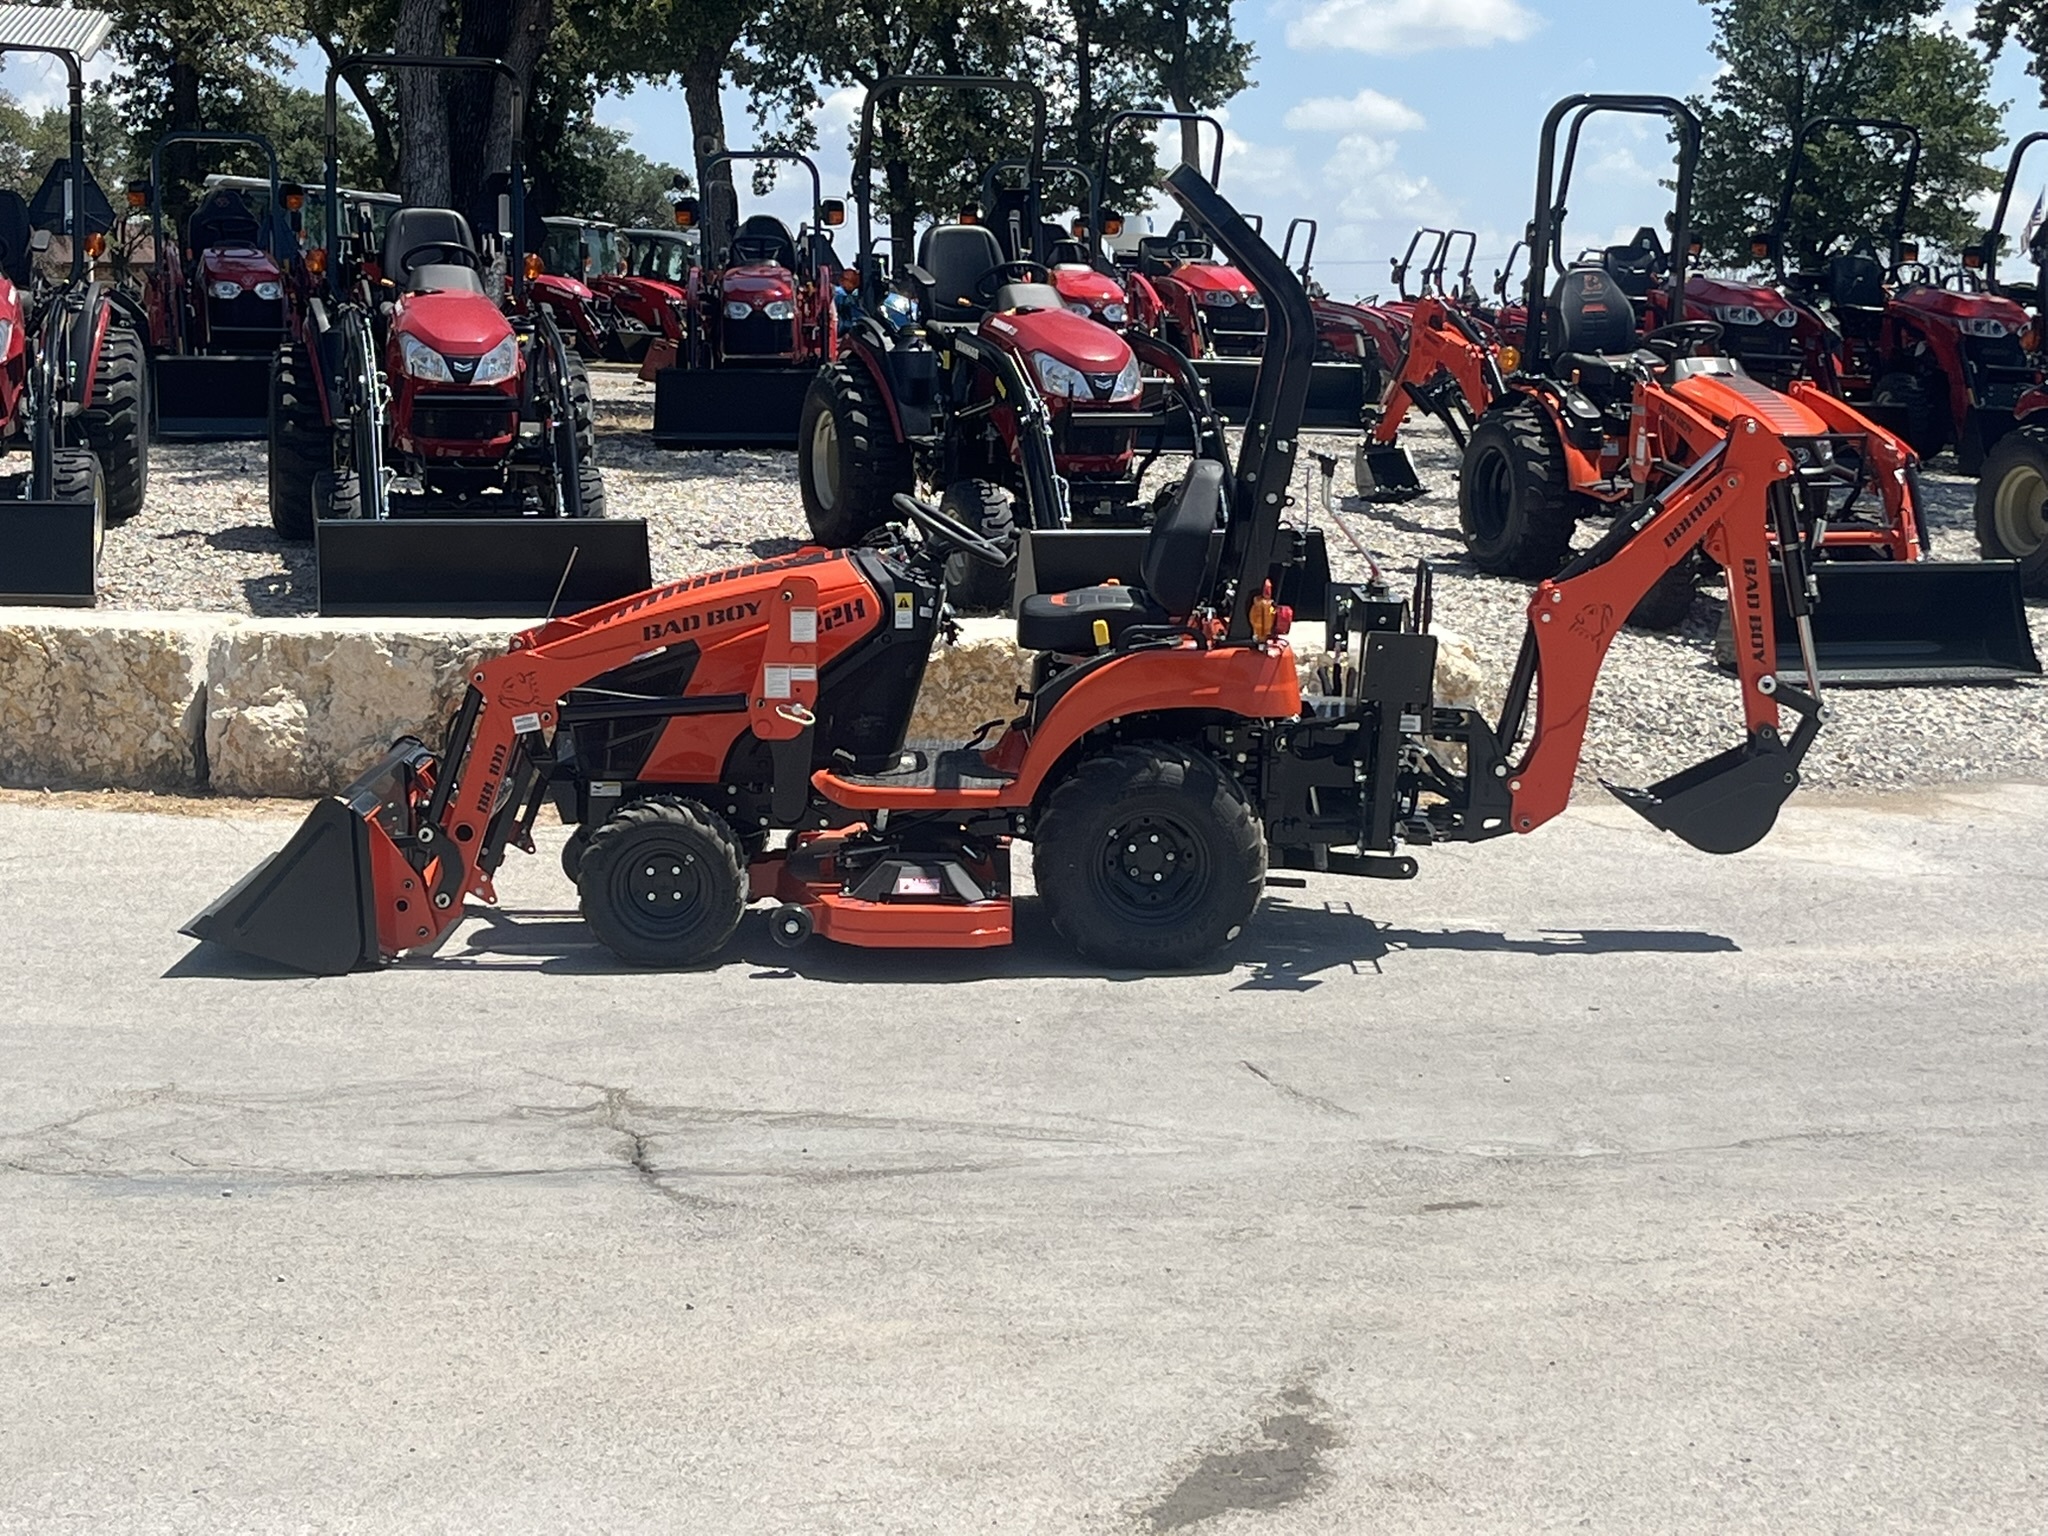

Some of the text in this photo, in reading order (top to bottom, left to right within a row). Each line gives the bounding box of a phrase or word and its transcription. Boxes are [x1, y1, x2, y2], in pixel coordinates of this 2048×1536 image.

[643, 615, 701, 642] BAD
[707, 600, 763, 627] BOY
[1743, 558, 1766, 665] BAD BOY
